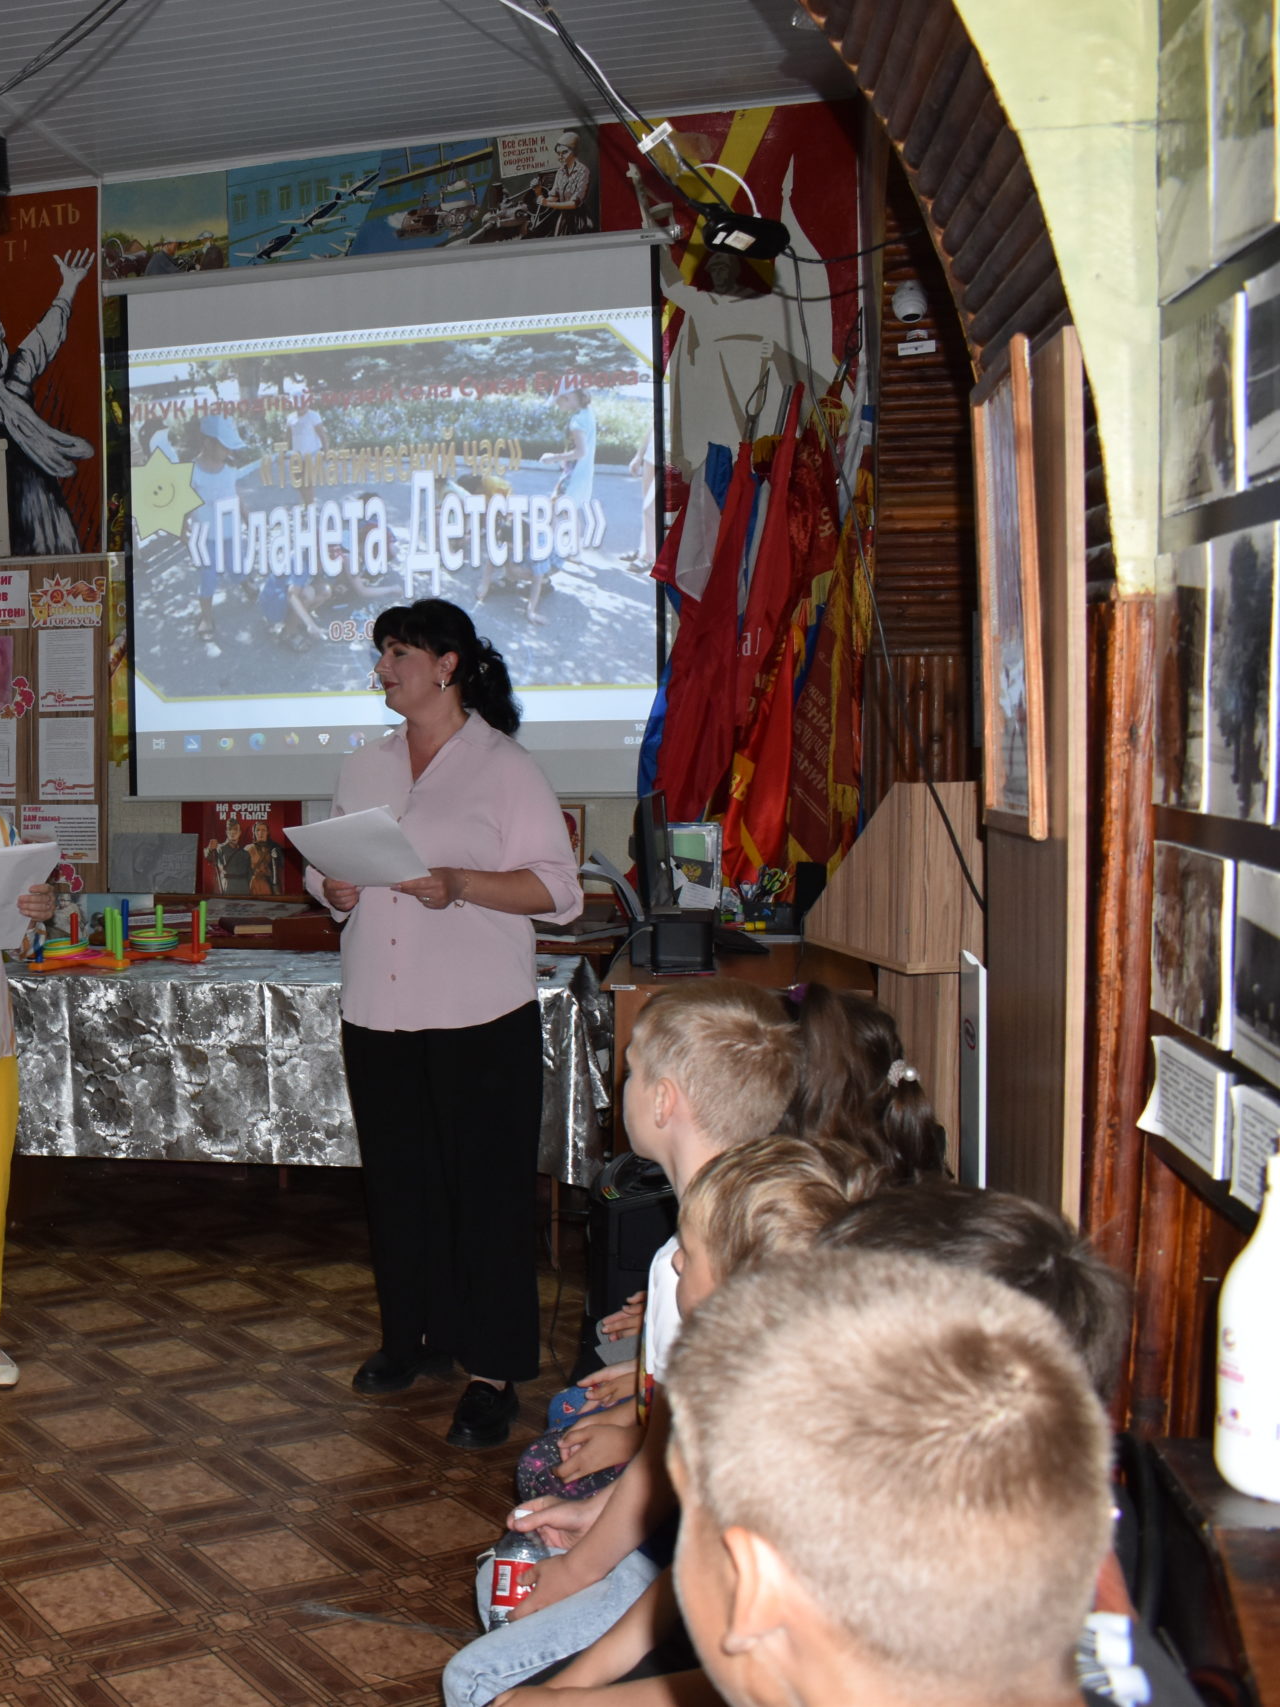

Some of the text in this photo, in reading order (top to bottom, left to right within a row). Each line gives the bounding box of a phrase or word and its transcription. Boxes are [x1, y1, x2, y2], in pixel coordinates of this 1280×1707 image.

[502, 140, 516, 150] ВСЕ
[540, 135, 546, 144] И
[463, 438, 521, 477] час»
[188, 469, 608, 600] «Планета Детства»
[216, 803, 271, 811] НА ФРОНТЕ
[220, 811, 227, 820] И
[240, 811, 267, 820] ТЫЛУ
